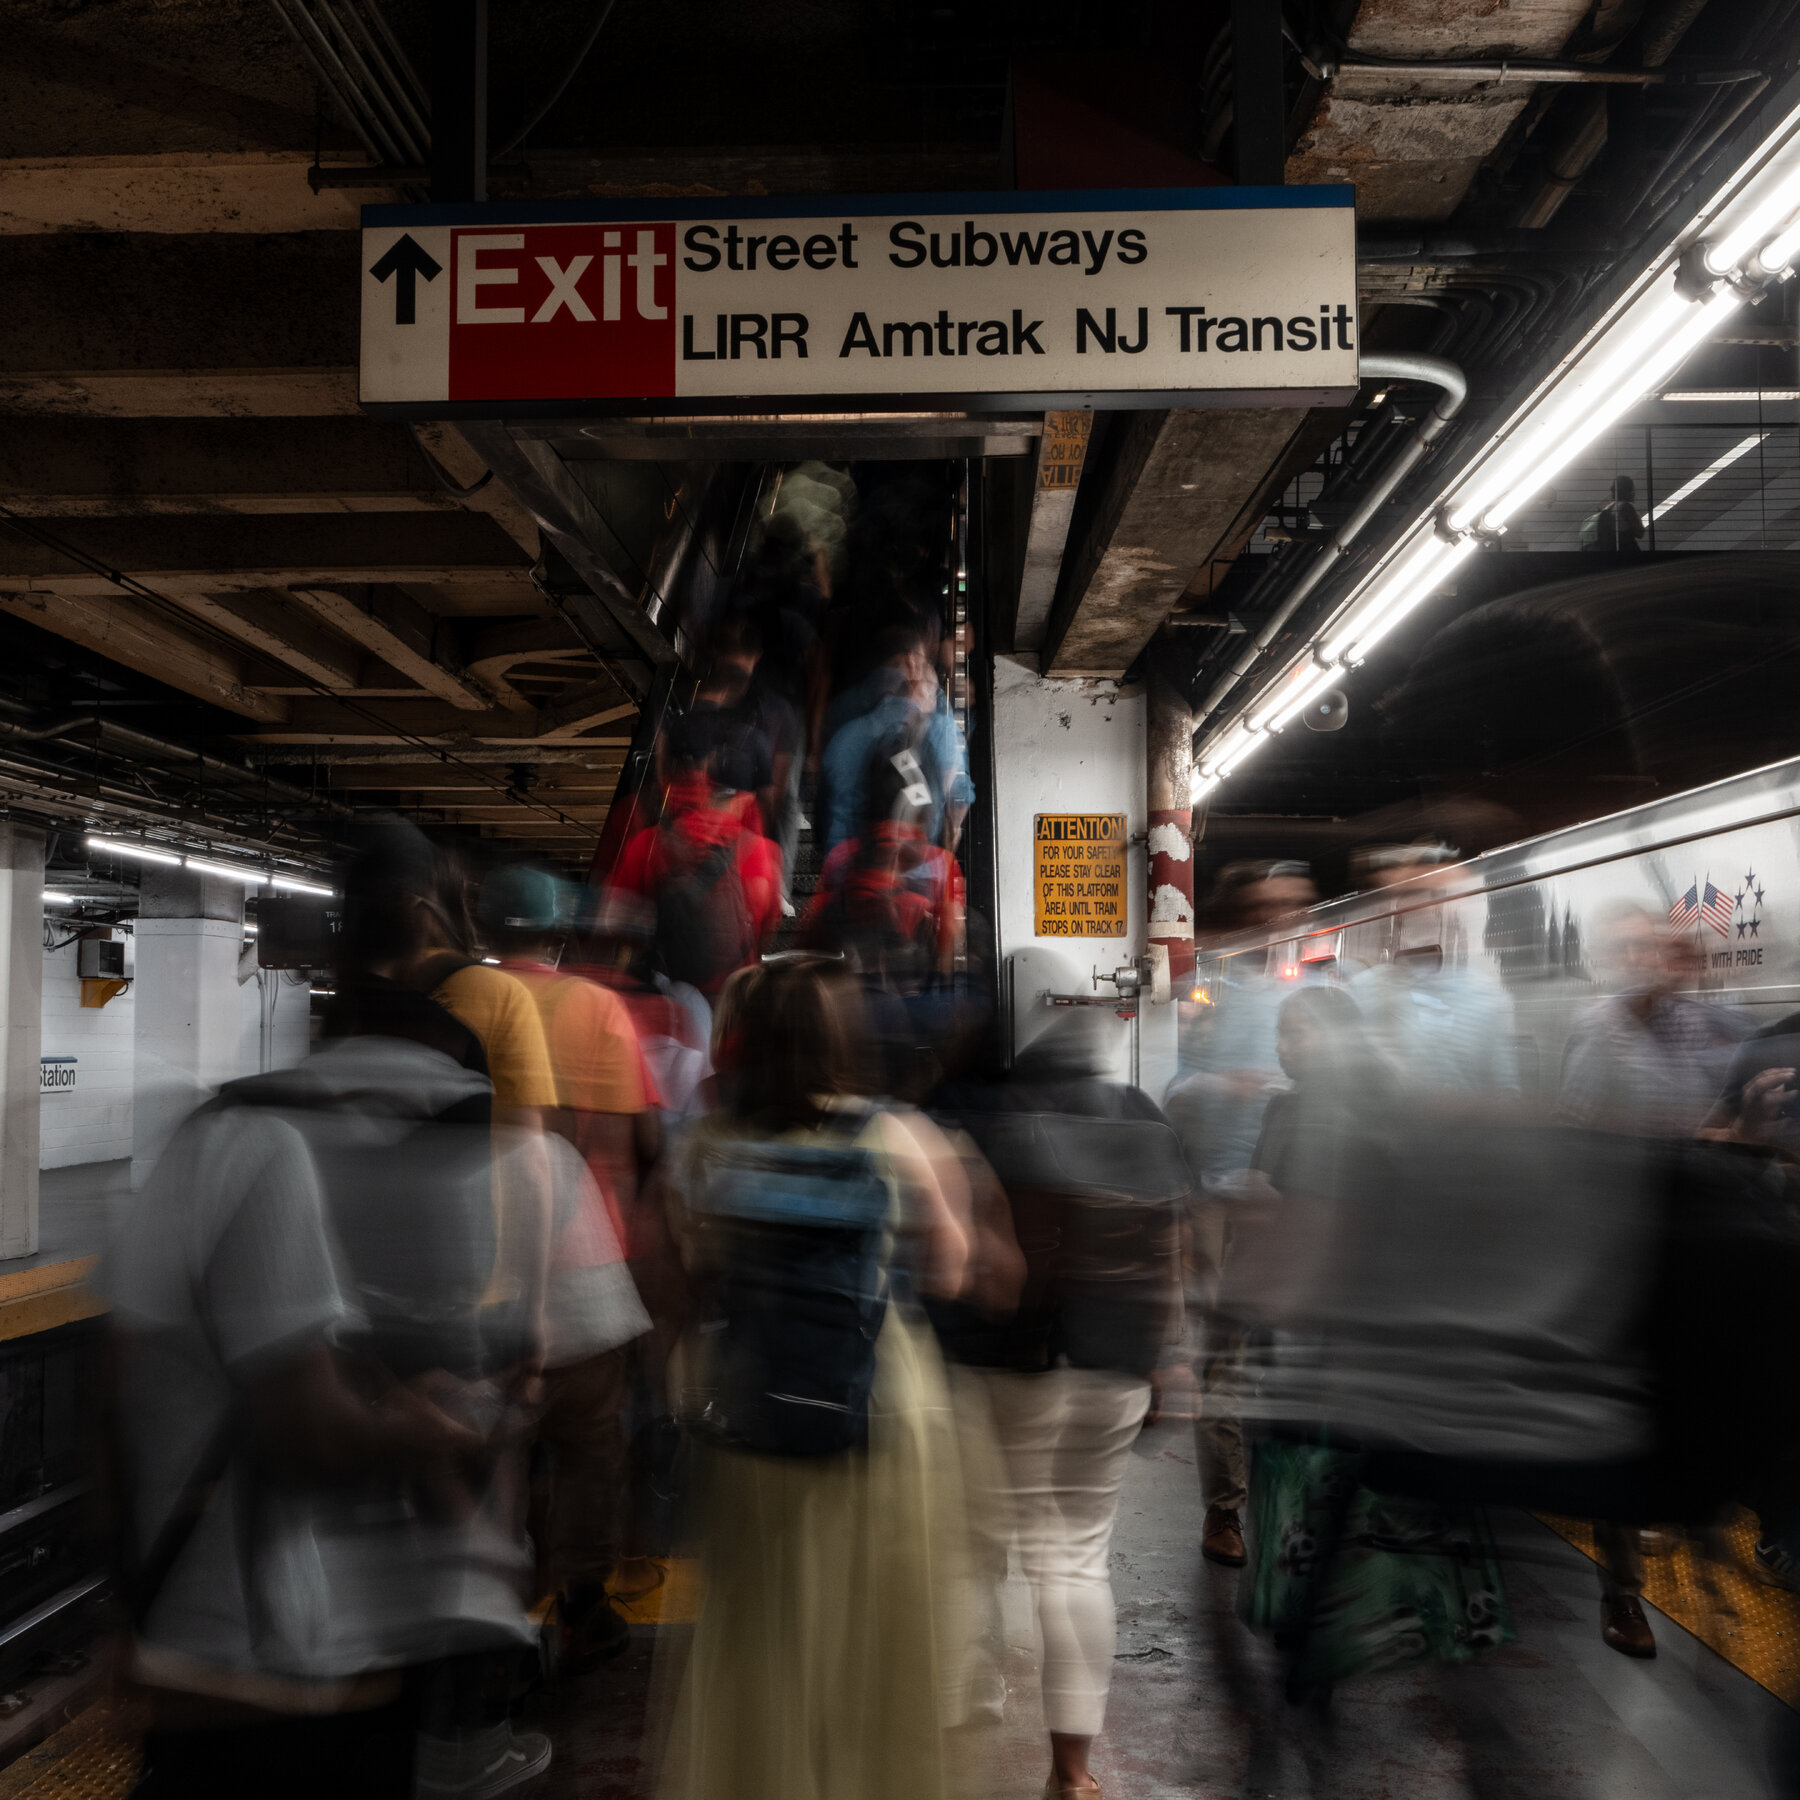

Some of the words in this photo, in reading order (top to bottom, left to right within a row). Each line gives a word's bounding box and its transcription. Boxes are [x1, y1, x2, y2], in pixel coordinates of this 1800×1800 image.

[682, 223, 859, 272] Street
[888, 220, 1148, 276] Subways
[456, 231, 669, 324] Exit
[682, 313, 810, 361] LIRR
[838, 309, 1046, 358] Amtrak
[1076, 306, 1149, 354] NJ
[1165, 304, 1355, 353] Transit
[1039, 817, 1123, 840] ATTENTION
[1043, 846, 1060, 860] FOR
[1062, 846, 1084, 860] YOUR
[1087, 846, 1118, 860] SAFETY
[1040, 865, 1070, 878] PLEASE
[1073, 865, 1092, 878] STAY
[1094, 865, 1121, 878] CLEAR
[1043, 883, 1054, 897] OF
[1057, 883, 1075, 897] THIS
[1077, 883, 1119, 897] PLATFORM
[1044, 902, 1066, 915] AREA
[1069, 902, 1091, 915] UNTIL
[1094, 902, 1118, 915] TRAIN
[1042, 920, 1069, 934] STOPS
[1071, 920, 1084, 934] ON
[1086, 920, 1113, 934] TRACK
[1115, 920, 1124, 934] 17
[1712, 951, 1733, 969] WITH
[1736, 948, 1763, 966] PRIDE
